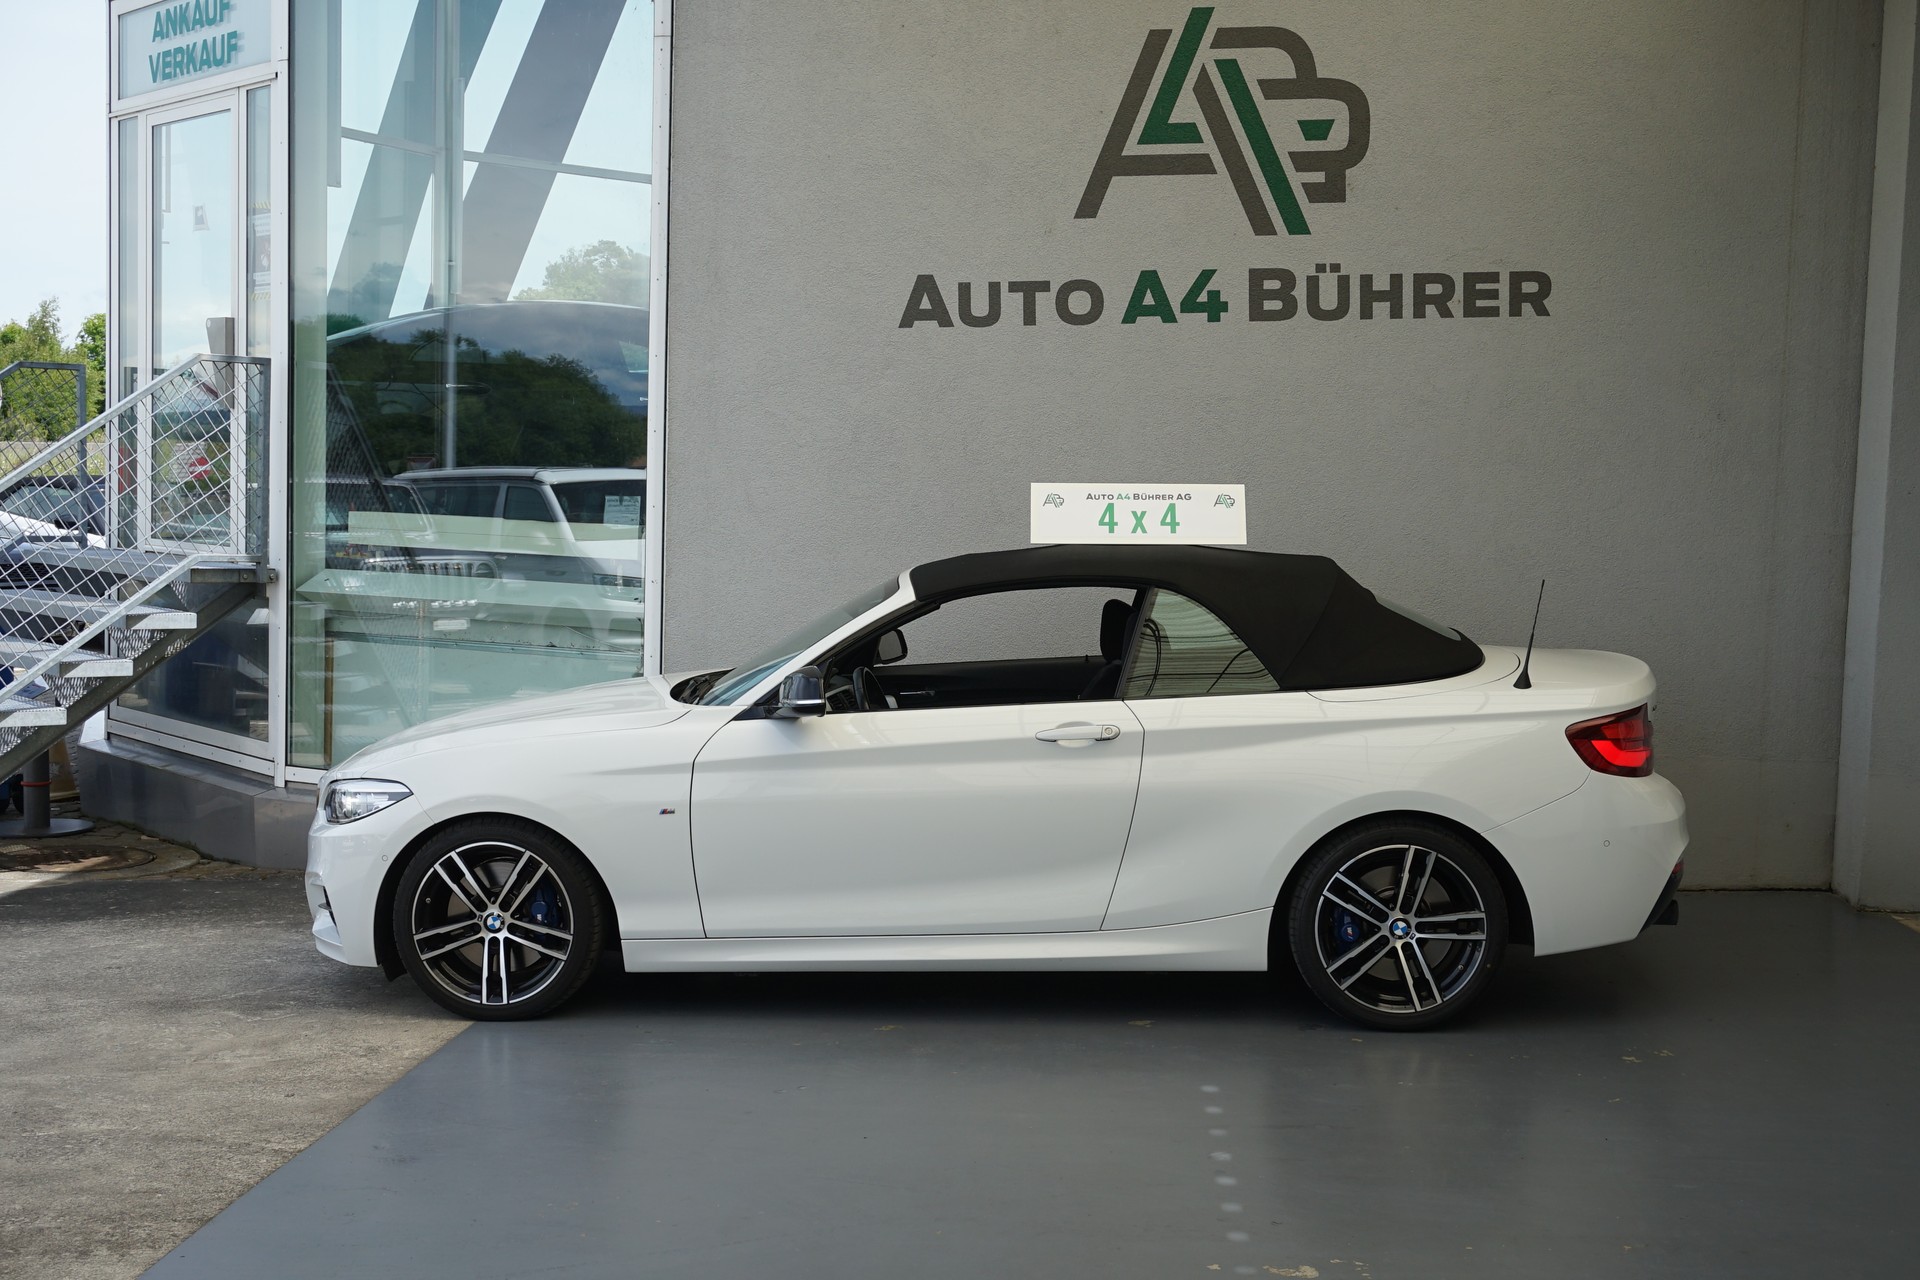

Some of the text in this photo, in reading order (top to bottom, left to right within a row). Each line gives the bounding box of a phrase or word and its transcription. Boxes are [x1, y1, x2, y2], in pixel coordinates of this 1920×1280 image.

[152, 0, 230, 42] ANKAUF
[148, 30, 238, 83] VERKAUF
[899, 263, 1553, 328] AUTO A4 BÜHRER
[1086, 493, 1192, 501] AUTO A4 BÜHRER AG
[1098, 502, 1180, 534] 4 x 4
